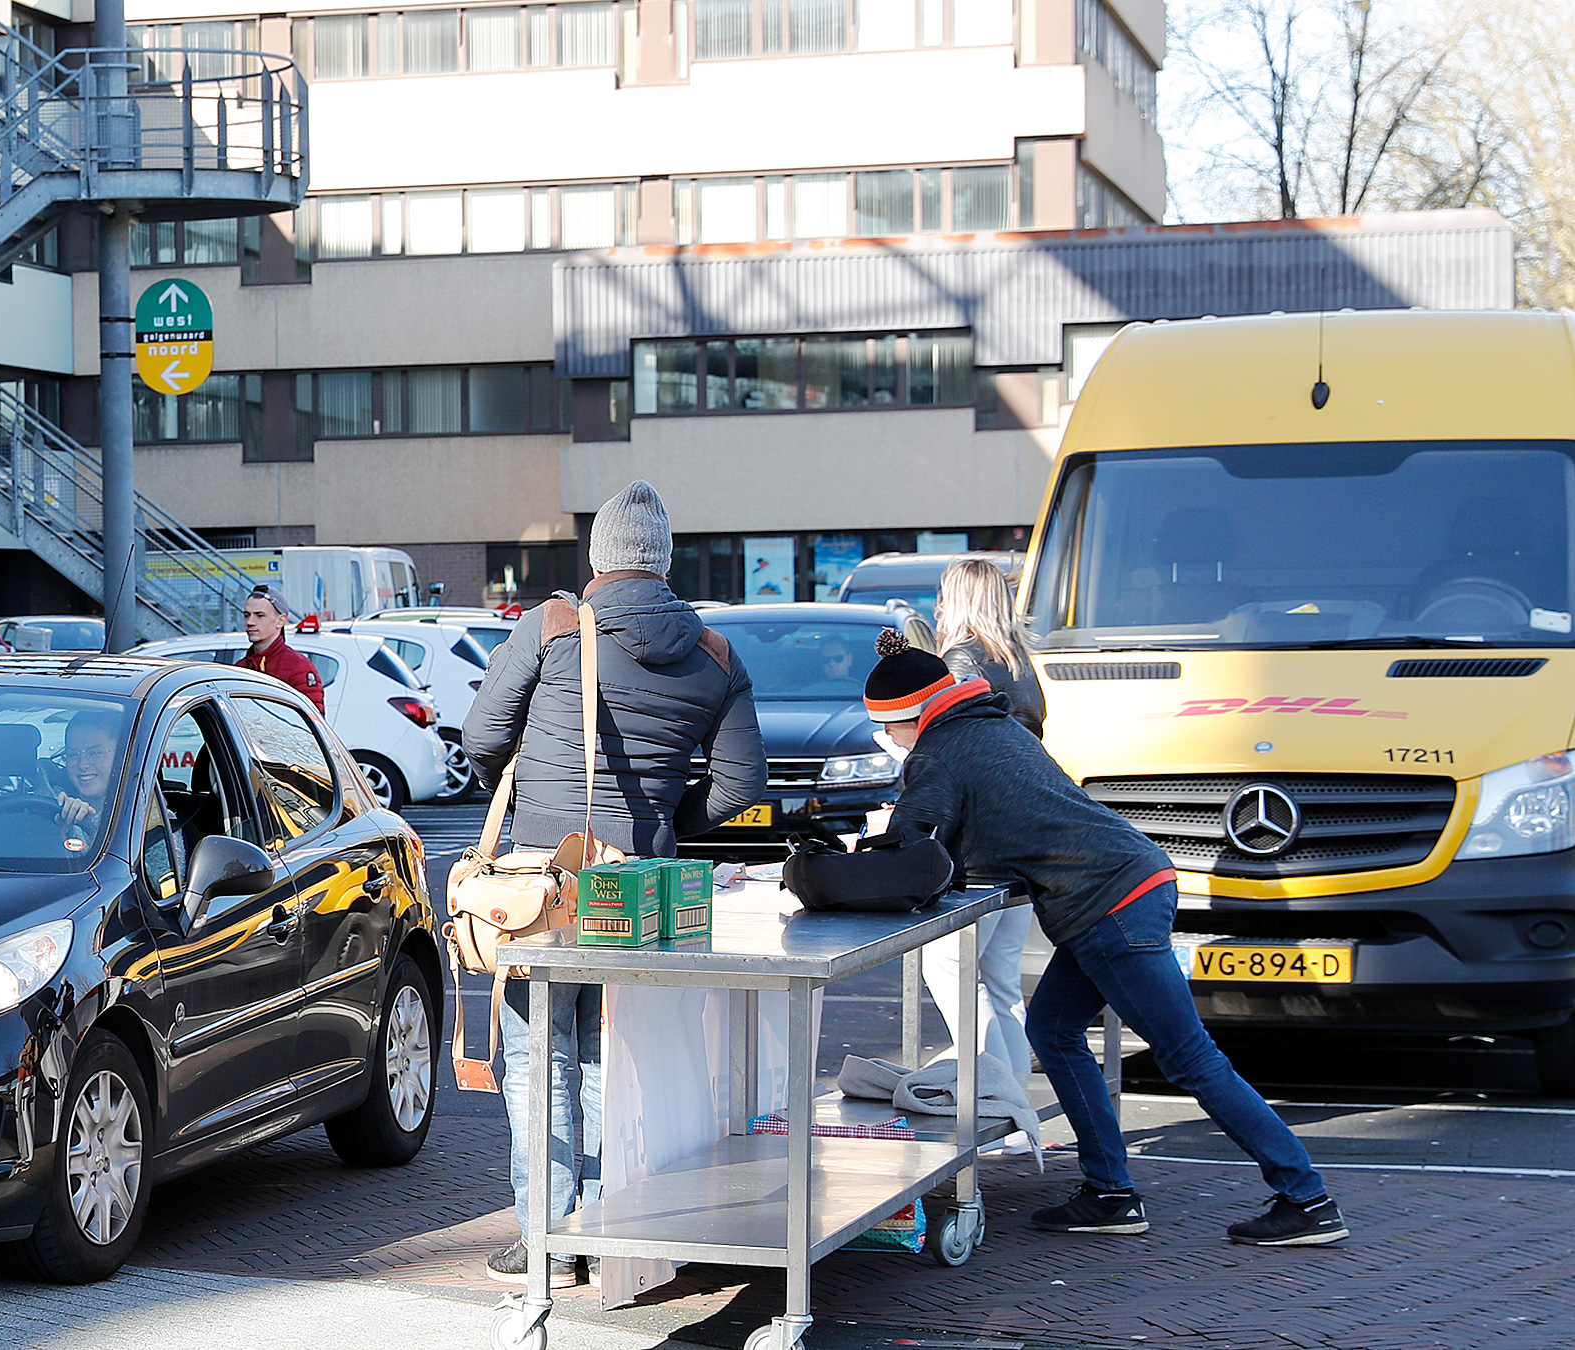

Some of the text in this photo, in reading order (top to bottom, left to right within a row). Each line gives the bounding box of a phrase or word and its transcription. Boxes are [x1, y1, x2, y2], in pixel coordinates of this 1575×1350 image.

[153, 314, 193, 327] west
[148, 341, 199, 356] noord
[1174, 696, 1371, 718] DHL
[1383, 748, 1455, 764] 17211
[589, 878, 618, 891] JOHN
[594, 889, 624, 900] WEST
[1198, 951, 1339, 977] VG-894-D
